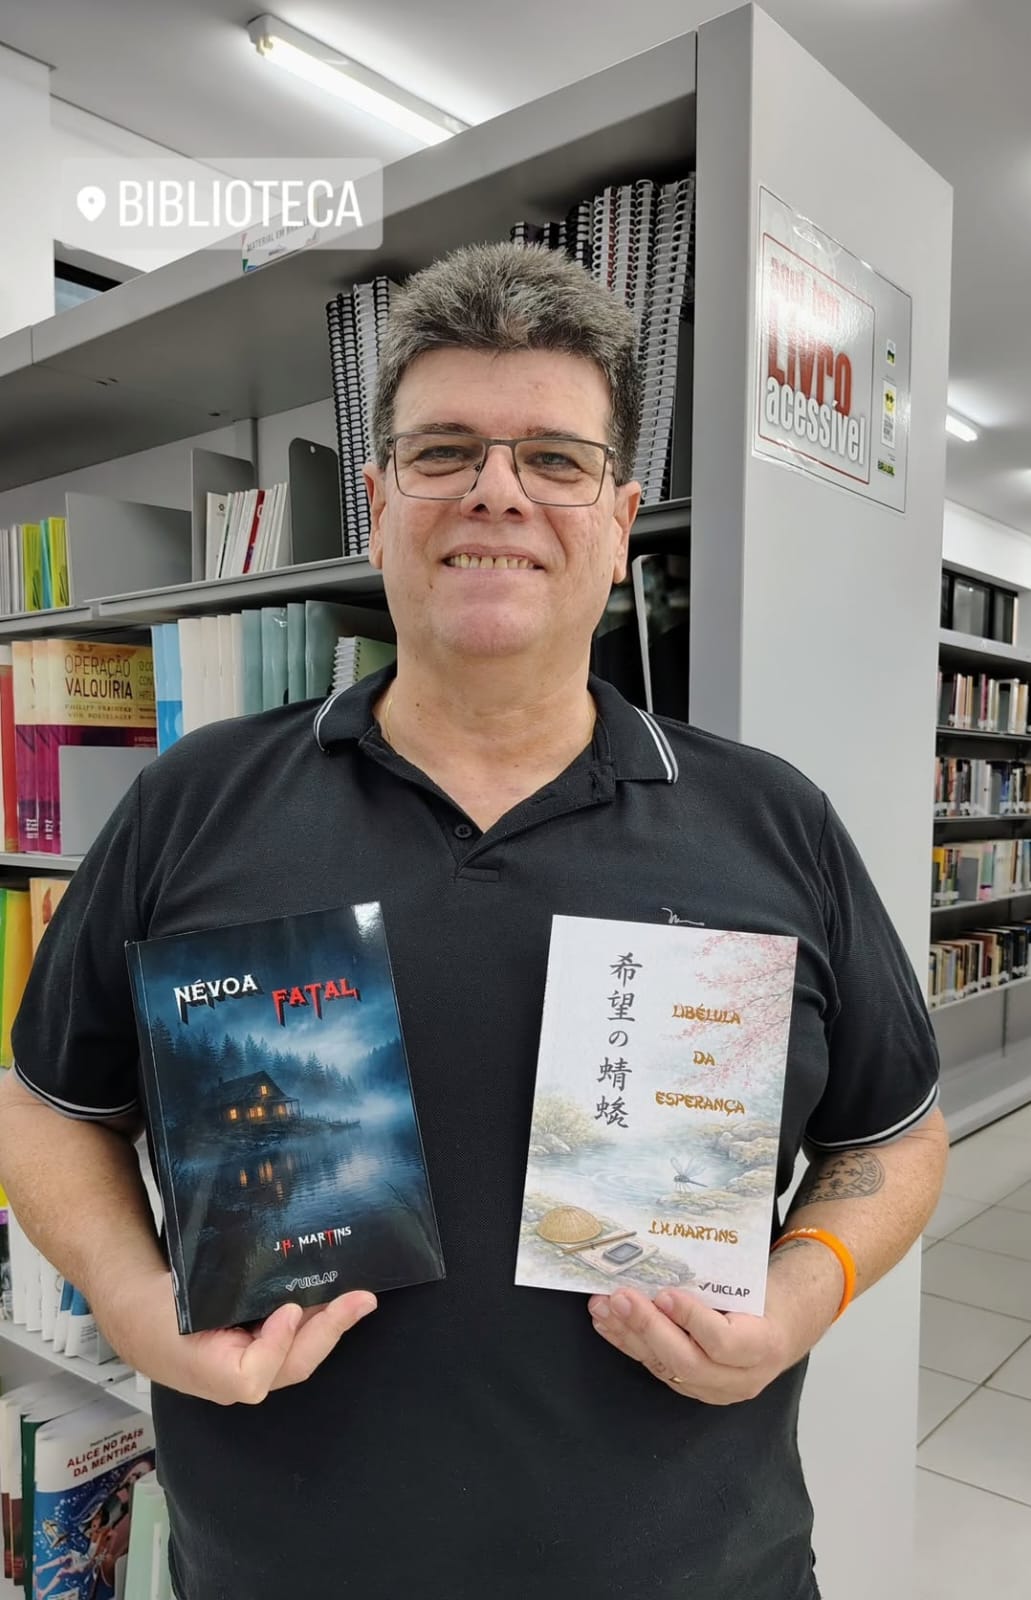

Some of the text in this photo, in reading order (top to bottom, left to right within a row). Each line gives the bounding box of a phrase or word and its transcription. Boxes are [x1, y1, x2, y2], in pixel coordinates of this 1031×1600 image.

[765, 377, 866, 464] acessível
[65, 654, 131, 678] OPERAÇÃO
[173, 974, 259, 1024] NÉVOA
[272, 978, 360, 1026] FATAL
[672, 1003, 741, 1025] LIBÉLULA
[693, 1050, 716, 1067] DA
[655, 1091, 745, 1117] ESPERANÇA
[298, 1226, 352, 1255] MARTINS
[298, 1270, 339, 1289] UICLAP
[711, 1283, 750, 1297] UICLAP
[67, 1447, 101, 1468] ALICE
[103, 1439, 118, 1453] NO
[73, 1466, 89, 1477] DA
[91, 1441, 138, 1469] MENTIRA
